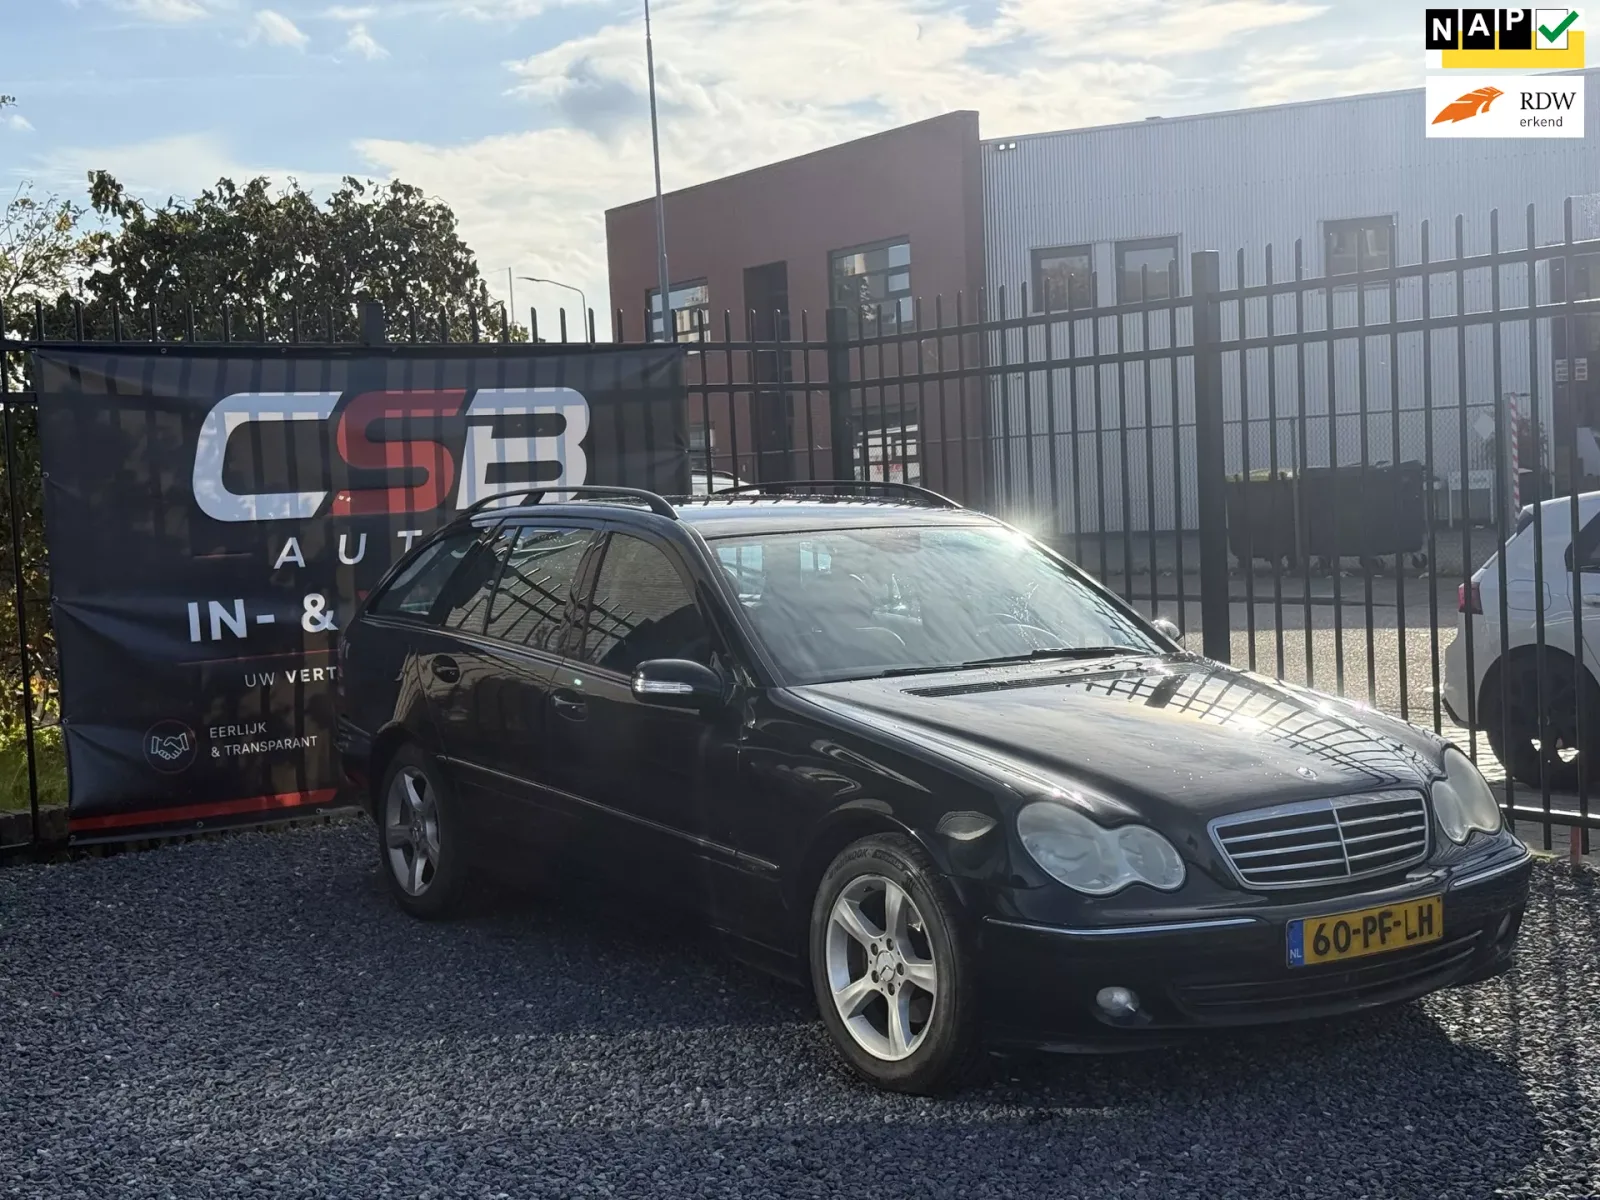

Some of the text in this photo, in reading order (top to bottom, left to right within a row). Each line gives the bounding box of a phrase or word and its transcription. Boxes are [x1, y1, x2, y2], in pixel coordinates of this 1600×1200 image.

[192, 386, 591, 522] CSB
[187, 592, 339, 643] IN- &
[244, 665, 337, 688] UW VERT
[209, 721, 267, 739] EERLIJK
[211, 734, 318, 758] & TRANSPARANT
[1289, 903, 1434, 959] NL 60-PF-LH
